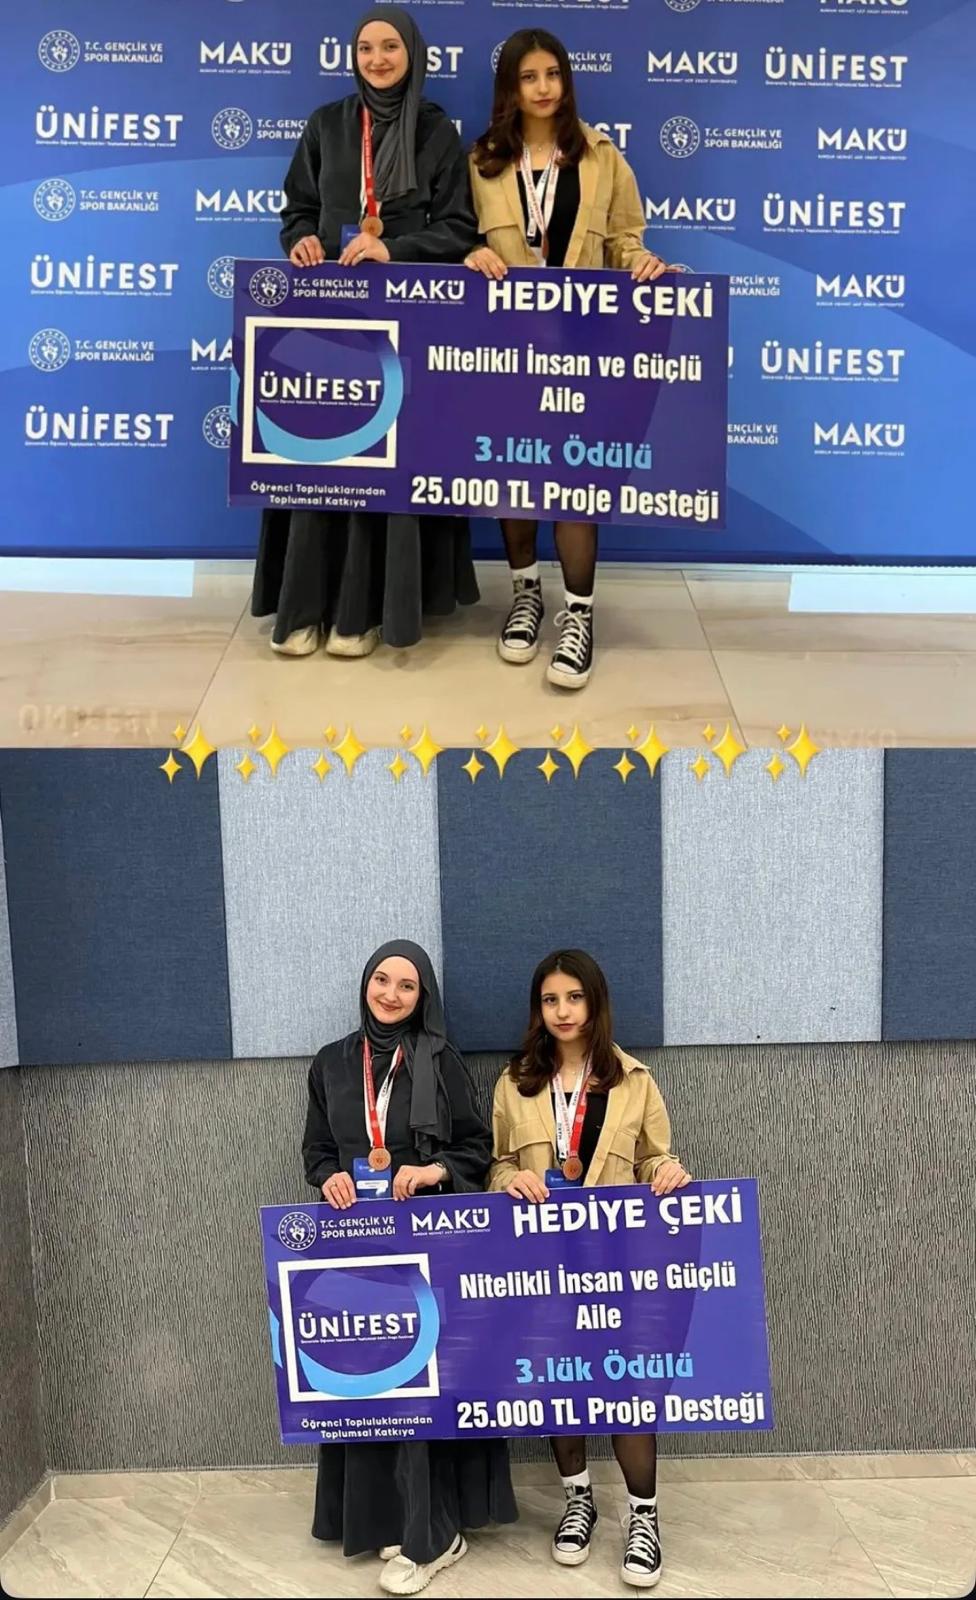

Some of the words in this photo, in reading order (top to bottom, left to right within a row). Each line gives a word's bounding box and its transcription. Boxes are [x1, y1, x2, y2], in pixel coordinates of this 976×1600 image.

[85, 42, 102, 52] T.C.
[105, 41, 147, 54] GENÇLİK
[150, 42, 162, 51] VE
[85, 52, 109, 63] SPOR
[112, 52, 163, 64] BAKANLIĞI
[200, 40, 292, 65] MAKÜ
[568, 51, 596, 62] NÇLİK
[599, 52, 612, 62] VE
[570, 62, 612, 73] KANLIĞI
[648, 50, 737, 75] MAKÜ
[766, 46, 908, 82] ÜNİFEST
[36, 105, 183, 141] ÜNİFEST
[257, 119, 274, 129] T.C.
[277, 119, 308, 131] GENÇ
[705, 129, 721, 138] T.C.
[724, 127, 767, 138] GENÇLİK
[769, 129, 782, 138] VE
[257, 130, 282, 140] SPOR
[705, 138, 729, 149] SPOR
[731, 137, 782, 150] BAKANLIĞI
[818, 128, 906, 152] MAKÜ
[80, 191, 98, 200] T.C.
[100, 190, 142, 202] GENÇLİK
[145, 191, 158, 200] VE
[80, 201, 105, 211] SPOR
[107, 200, 159, 212] BAKANLIĞI
[196, 189, 287, 213] MAKÜ
[647, 197, 735, 221] MAKÜ
[764, 193, 905, 227] ÜNİFEST
[31, 255, 179, 289] ÜNİFEST
[293, 279, 310, 288] T.C.
[312, 278, 353, 289] GENÇLİK
[356, 280, 369, 289] VE
[729, 274, 764, 286] ENÇLİK
[768, 276, 780, 285] VE
[293, 289, 317, 299] SPOR
[320, 289, 369, 299] BAKANLIĞI
[386, 279, 465, 300] MAKÜ
[816, 275, 904, 298] MAKÜ
[488, 276, 619, 316] HEDİYE
[632, 282, 713, 324] ÇEKİ
[75, 340, 92, 350] T.C.
[96, 339, 138, 352] GENÇLİK
[141, 341, 154, 351] VE
[75, 351, 100, 361] SPOR
[102, 350, 154, 362] BAKANLIĞI
[192, 338, 232, 361] MA
[428, 345, 518, 374] Nitelikli
[527, 344, 590, 377] İnsan
[598, 359, 625, 379] ve
[633, 353, 701, 383] Güçlü
[762, 340, 904, 375] ÜNİFEST
[260, 371, 381, 401] ÜNİFEST
[540, 387, 585, 413] Aile
[26, 406, 174, 440] ÜNİFEST
[728, 423, 763, 434] ENÇLİK
[766, 424, 778, 433] VE
[727, 435, 778, 445] BAKANLIĞI
[814, 423, 904, 447] MAKÜ
[475, 436, 551, 465] 3.lük
[563, 435, 652, 470] Ödülü
[251, 481, 293, 493] Öğrenci
[296, 484, 385, 496] Topluluklarından
[410, 476, 498, 507] 25.000
[506, 481, 535, 508] TL
[543, 482, 611, 516] Proje
[621, 486, 718, 522] Desteği
[270, 495, 322, 506] Toplumsal
[325, 496, 366, 507] Katkıya
[320, 1219, 337, 1229] T.C.
[340, 1217, 380, 1229] GENÇLİK
[382, 1216, 395, 1225] VE
[411, 1208, 490, 1231] MAKÜ
[513, 1195, 646, 1237] HEDİYE
[659, 1187, 742, 1235] ÇEKİ
[321, 1228, 345, 1239] SPOR
[347, 1226, 396, 1237] BAKANLIĞI
[460, 1269, 550, 1299] Nitelikli
[558, 1264, 623, 1294] İnsan
[630, 1271, 658, 1290] ve
[665, 1261, 736, 1290] Güçlü
[299, 1310, 417, 1338] ÜNİFEST
[576, 1304, 622, 1330] Aile
[515, 1356, 594, 1384] 3.lük
[603, 1350, 693, 1380] Ödülü
[457, 1399, 543, 1428] 25.000
[551, 1399, 580, 1425] TL
[588, 1396, 656, 1427] Proje
[665, 1392, 765, 1424] Desteği
[301, 1418, 342, 1429] Öğrenci
[345, 1415, 432, 1428] Topluluklarından
[321, 1429, 371, 1439] Toplumsal
[375, 1427, 415, 1438] Katkıya
